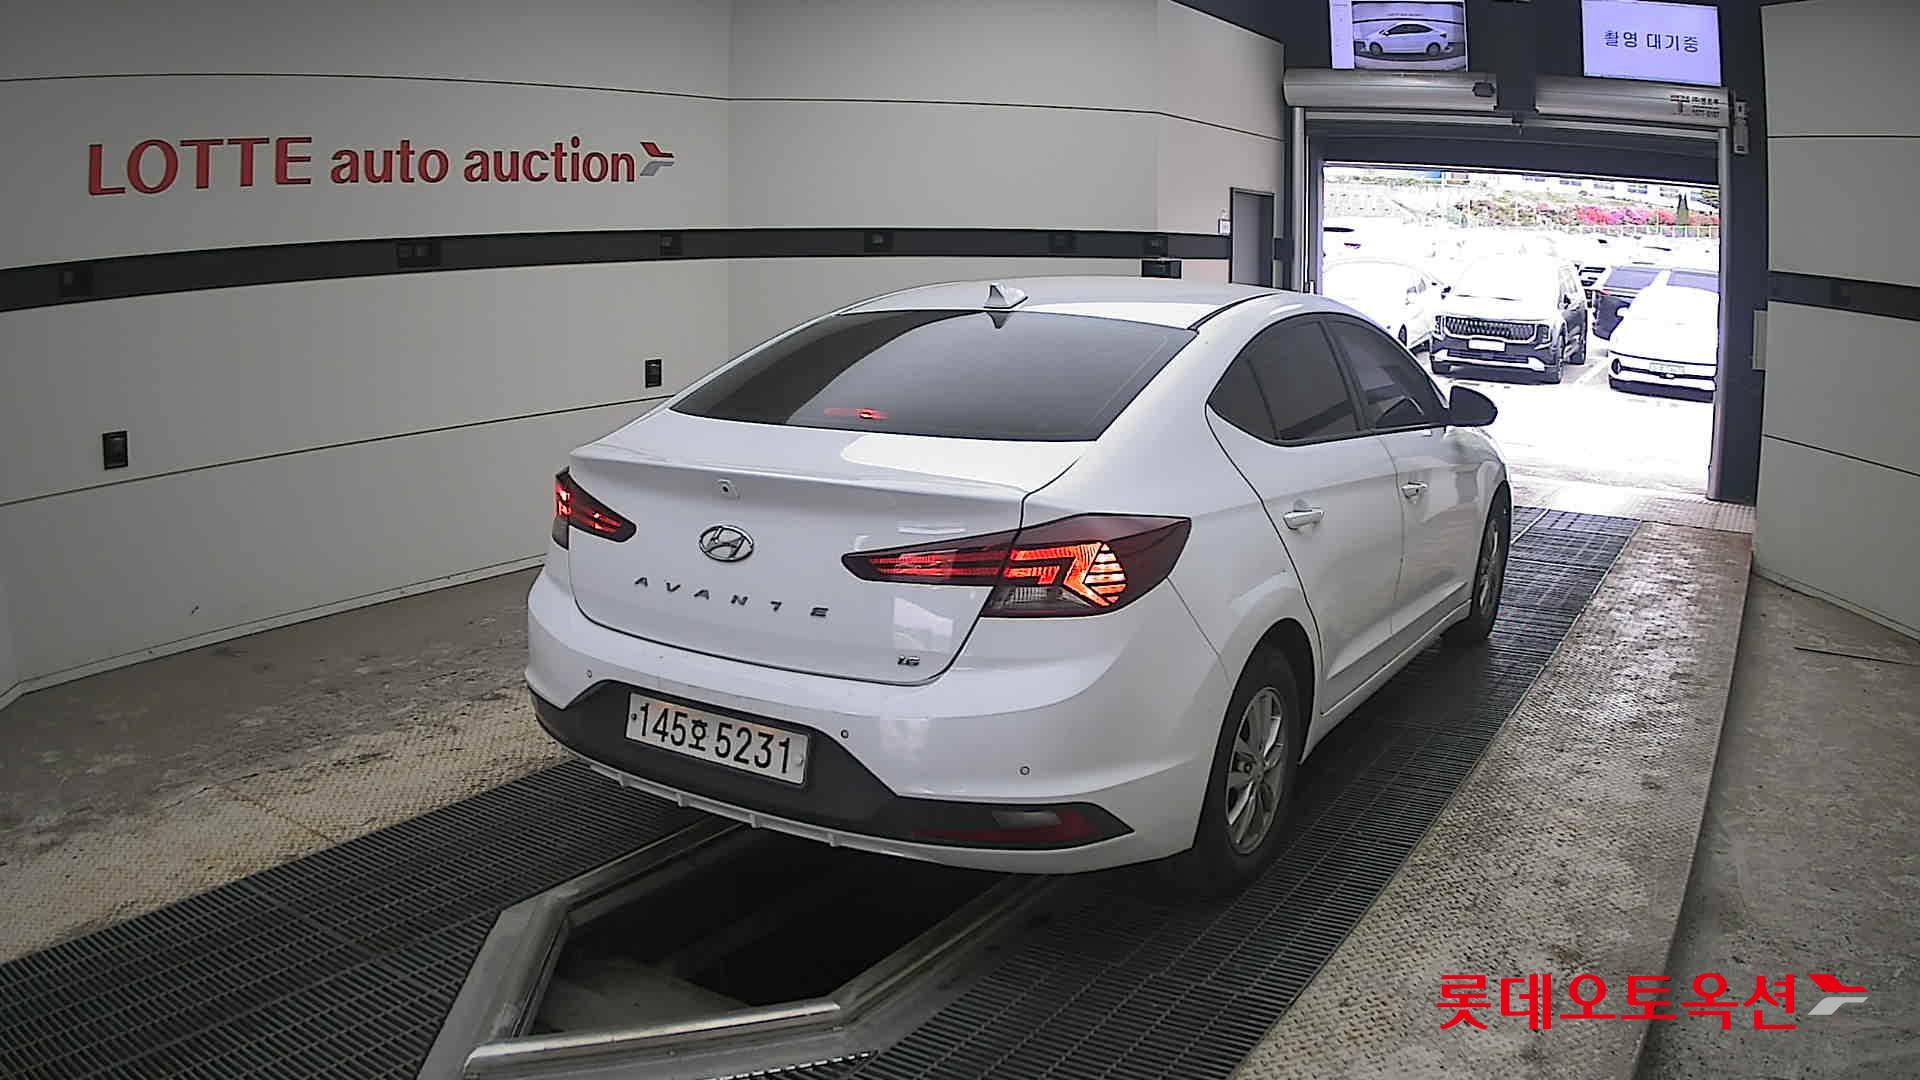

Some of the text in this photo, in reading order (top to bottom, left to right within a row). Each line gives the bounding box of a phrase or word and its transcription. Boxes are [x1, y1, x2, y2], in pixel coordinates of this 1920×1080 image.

[1605, 30, 1699, 53] 촬영 대기중
[88, 136, 636, 197] LOTTE auto auction
[634, 576, 830, 618] AVANTE
[640, 702, 791, 775] 145호 5231
